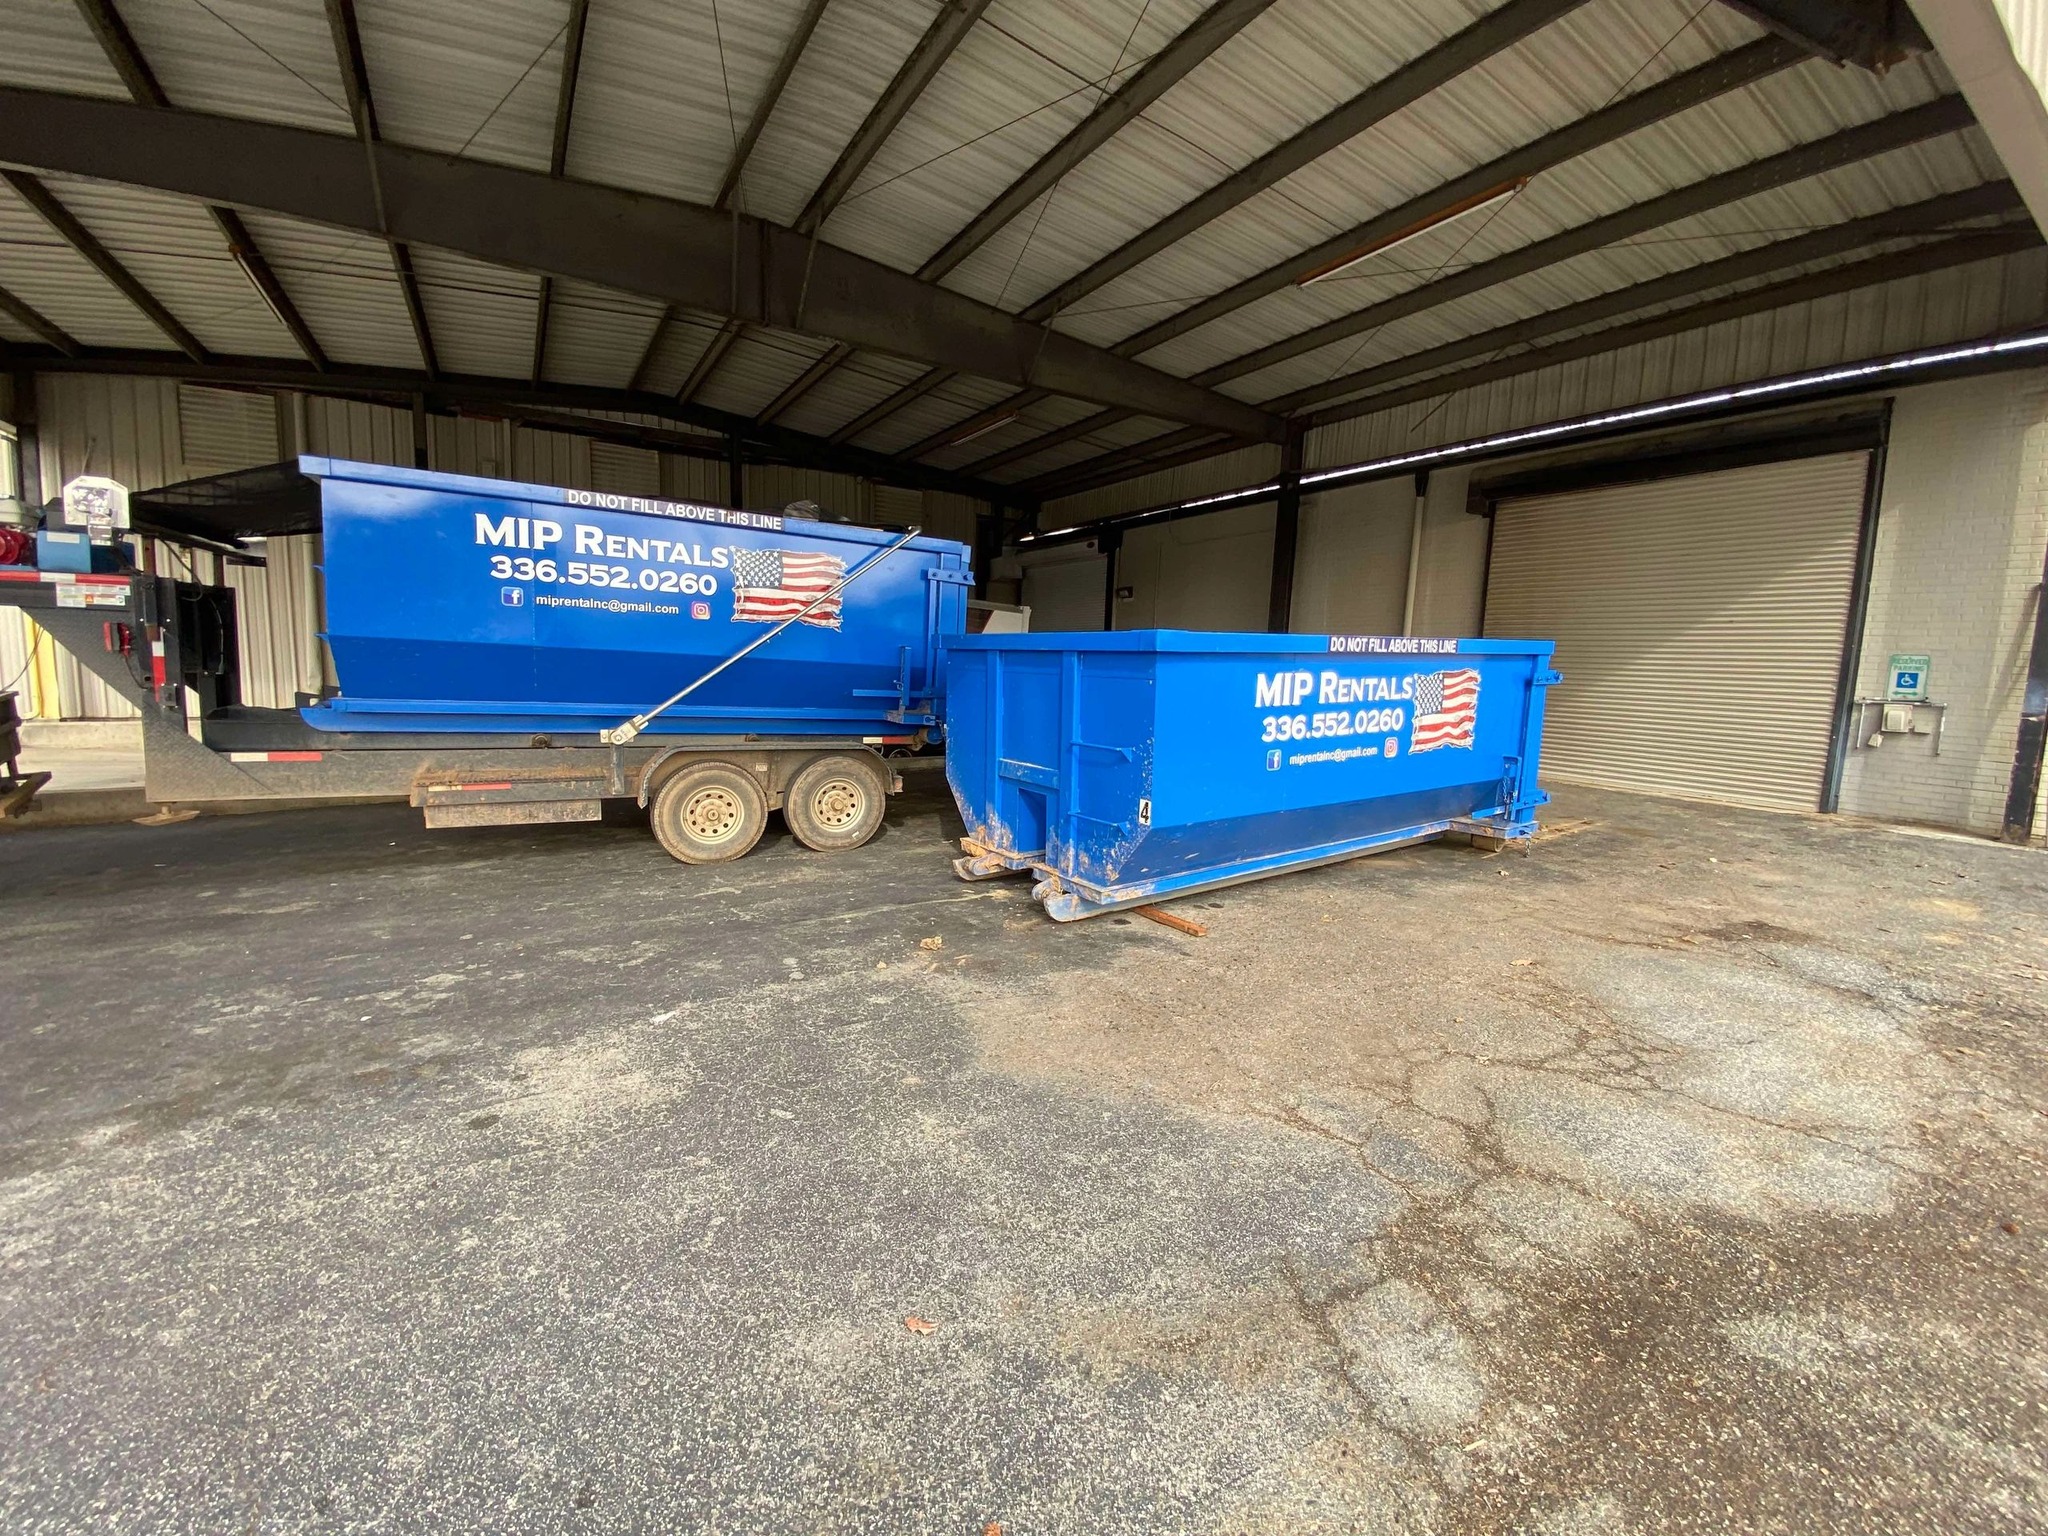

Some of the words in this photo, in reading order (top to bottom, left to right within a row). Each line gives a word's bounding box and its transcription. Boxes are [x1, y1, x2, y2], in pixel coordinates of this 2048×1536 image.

[568, 490, 591, 505] DO
[596, 494, 627, 509] NOT
[631, 498, 662, 514] FILL
[665, 502, 715, 522] ABOVE
[718, 510, 749, 526] THIS
[752, 515, 782, 530] LINE
[475, 513, 563, 550] MIP
[490, 555, 718, 596] 336.552.0260
[1330, 637, 1346, 652] DO
[1347, 637, 1369, 652] NOT
[1368, 638, 1388, 653] FILL
[1388, 638, 1419, 653] ABOVE
[1420, 639, 1438, 653] THIS
[1438, 640, 1457, 654] LINE
[1254, 671, 1313, 708] MIP
[1261, 707, 1404, 743] 336.552.0260
[1140, 801, 1149, 823] 4
